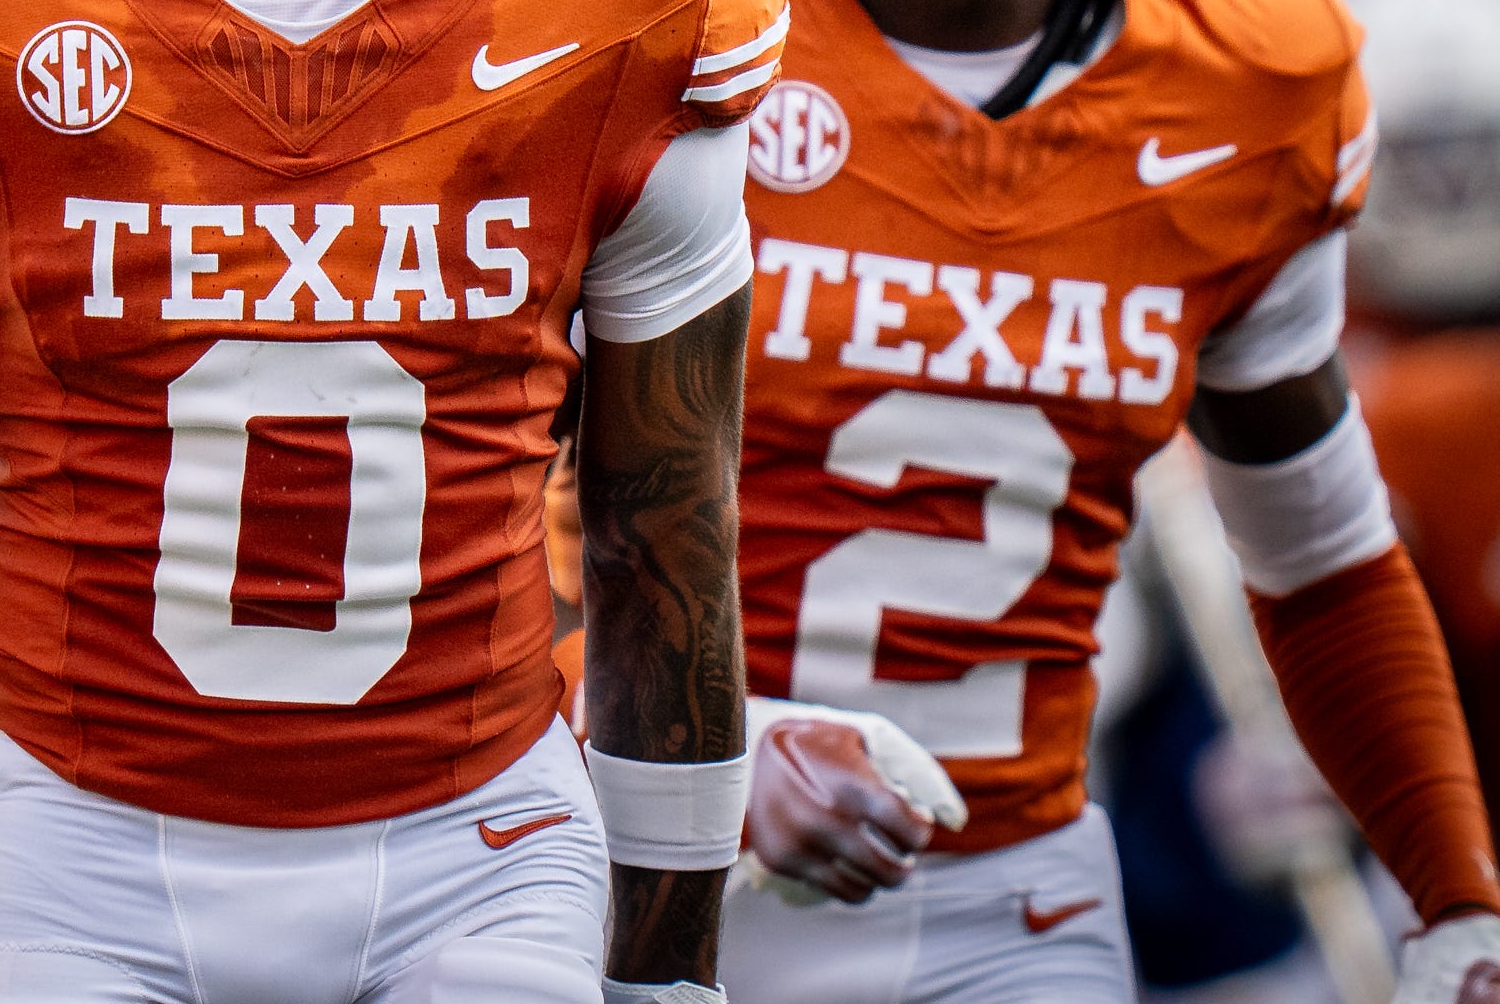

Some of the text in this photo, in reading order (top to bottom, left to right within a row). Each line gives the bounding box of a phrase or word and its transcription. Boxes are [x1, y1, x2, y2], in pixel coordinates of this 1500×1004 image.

[25, 29, 121, 126] SEC
[749, 91, 841, 181] SEC
[63, 197, 530, 321] TEXAS
[757, 237, 1184, 406] TEXAS
[152, 339, 426, 705] 0
[790, 388, 1076, 757] 2
